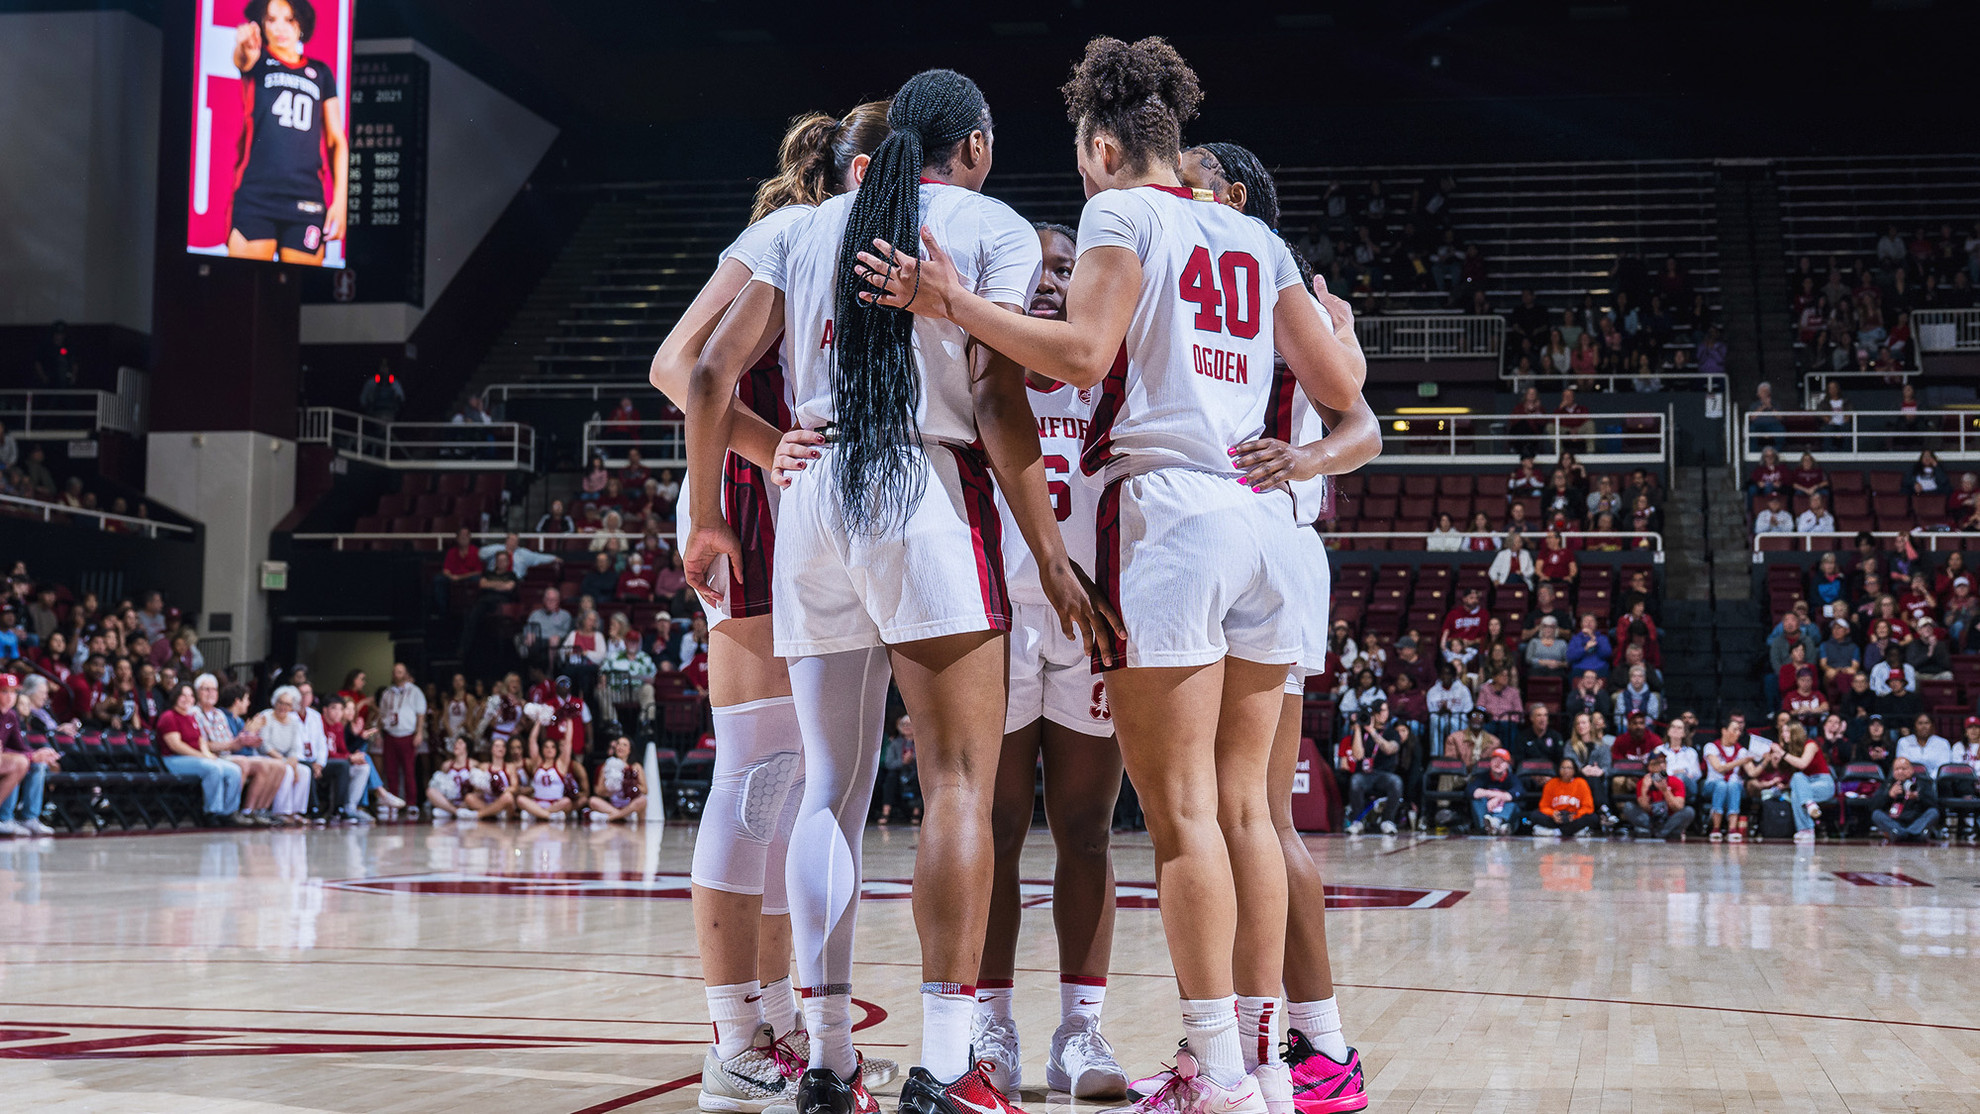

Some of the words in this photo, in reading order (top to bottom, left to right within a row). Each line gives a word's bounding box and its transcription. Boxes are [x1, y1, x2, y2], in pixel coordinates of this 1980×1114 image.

[271, 89, 314, 131] 40
[1179, 244, 1260, 340] 40
[1193, 343, 1248, 385] OGDEN
